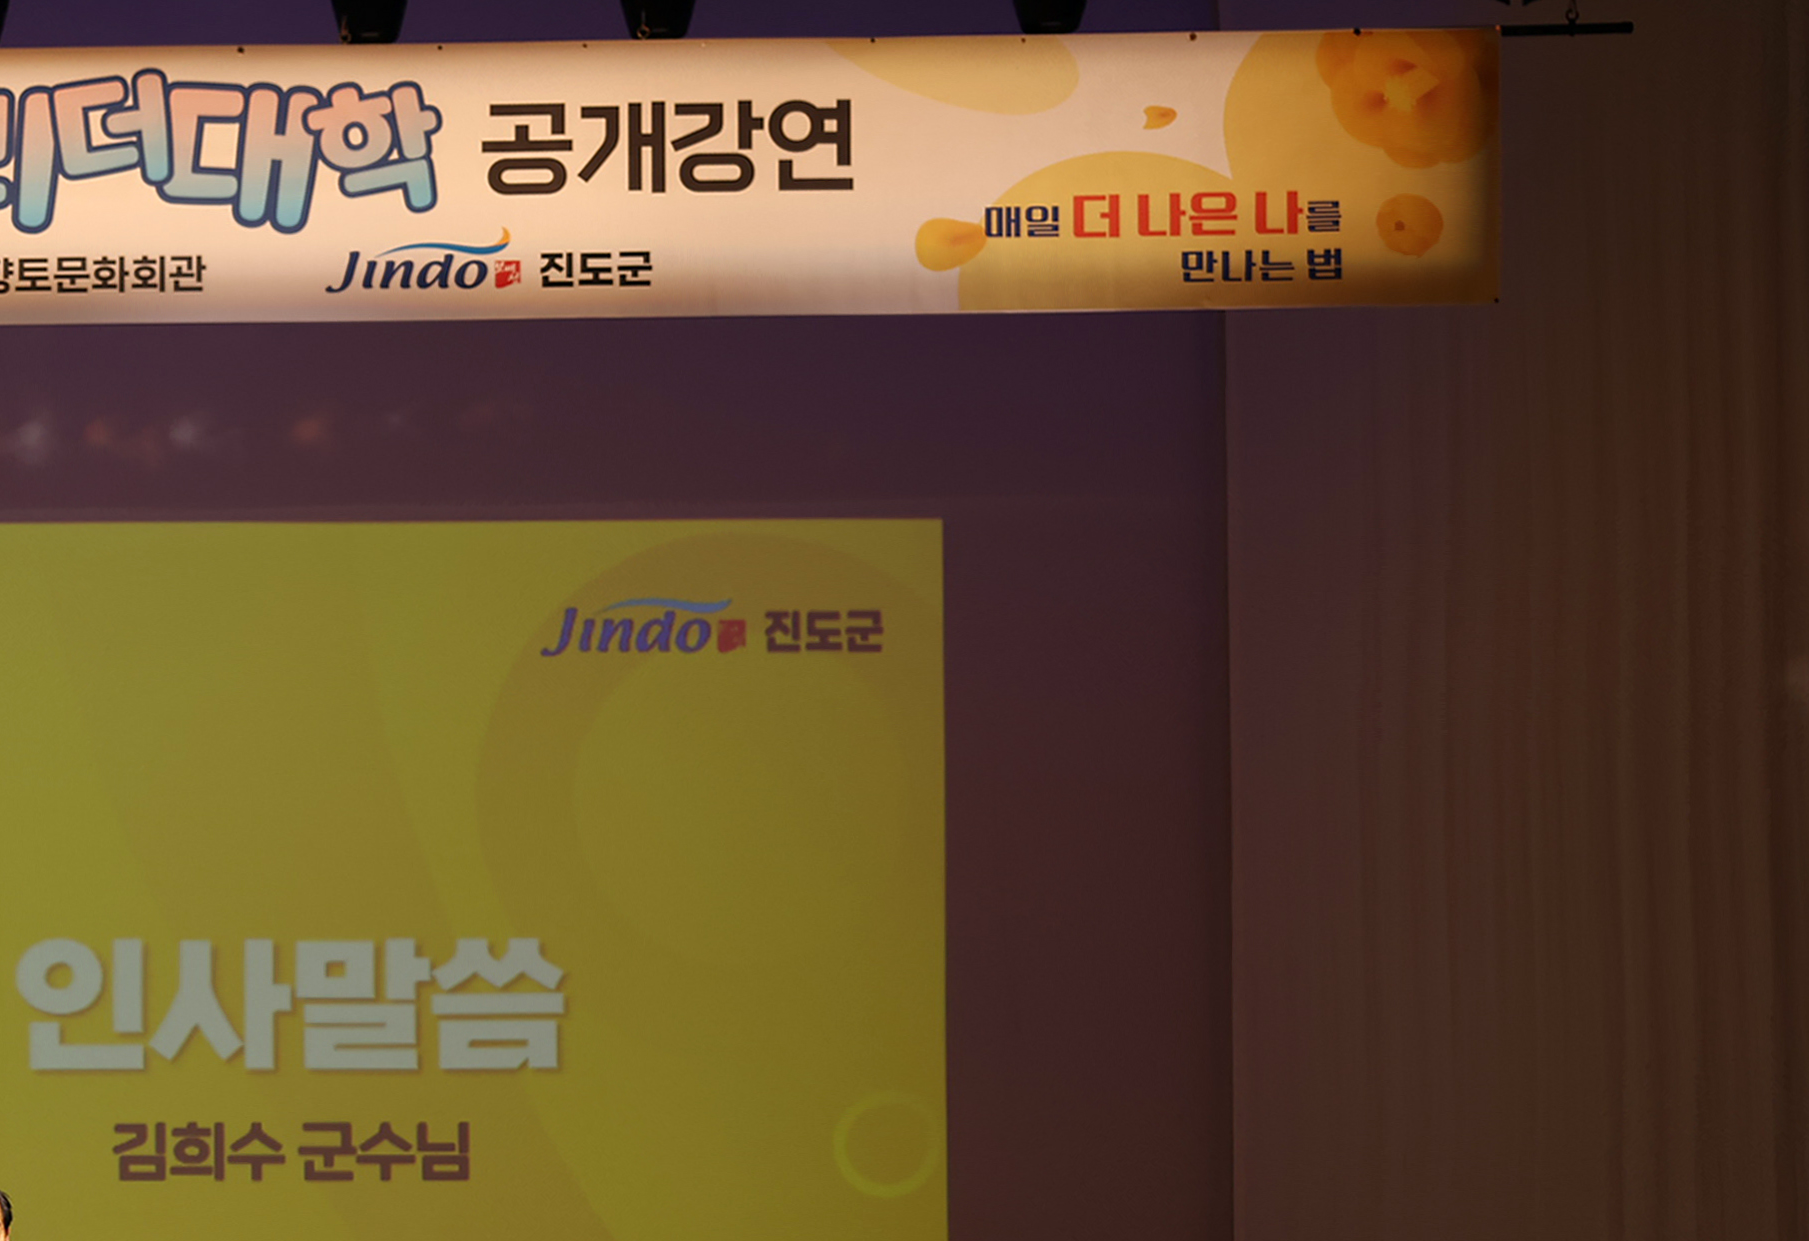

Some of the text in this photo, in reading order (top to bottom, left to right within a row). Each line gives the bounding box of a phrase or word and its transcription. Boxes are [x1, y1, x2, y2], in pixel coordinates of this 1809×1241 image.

[481, 99, 855, 195] 공개강연
[984, 190, 1342, 239] 매일 더 나은 나를
[325, 250, 488, 293] Jindo
[539, 250, 653, 289] 진도군
[1181, 247, 1343, 283] 만나는 법
[540, 607, 712, 657] Jindo
[764, 609, 884, 654] 진도군
[15, 937, 566, 1072] 인사말씀
[112, 1121, 471, 1182] 김희수 군수님
